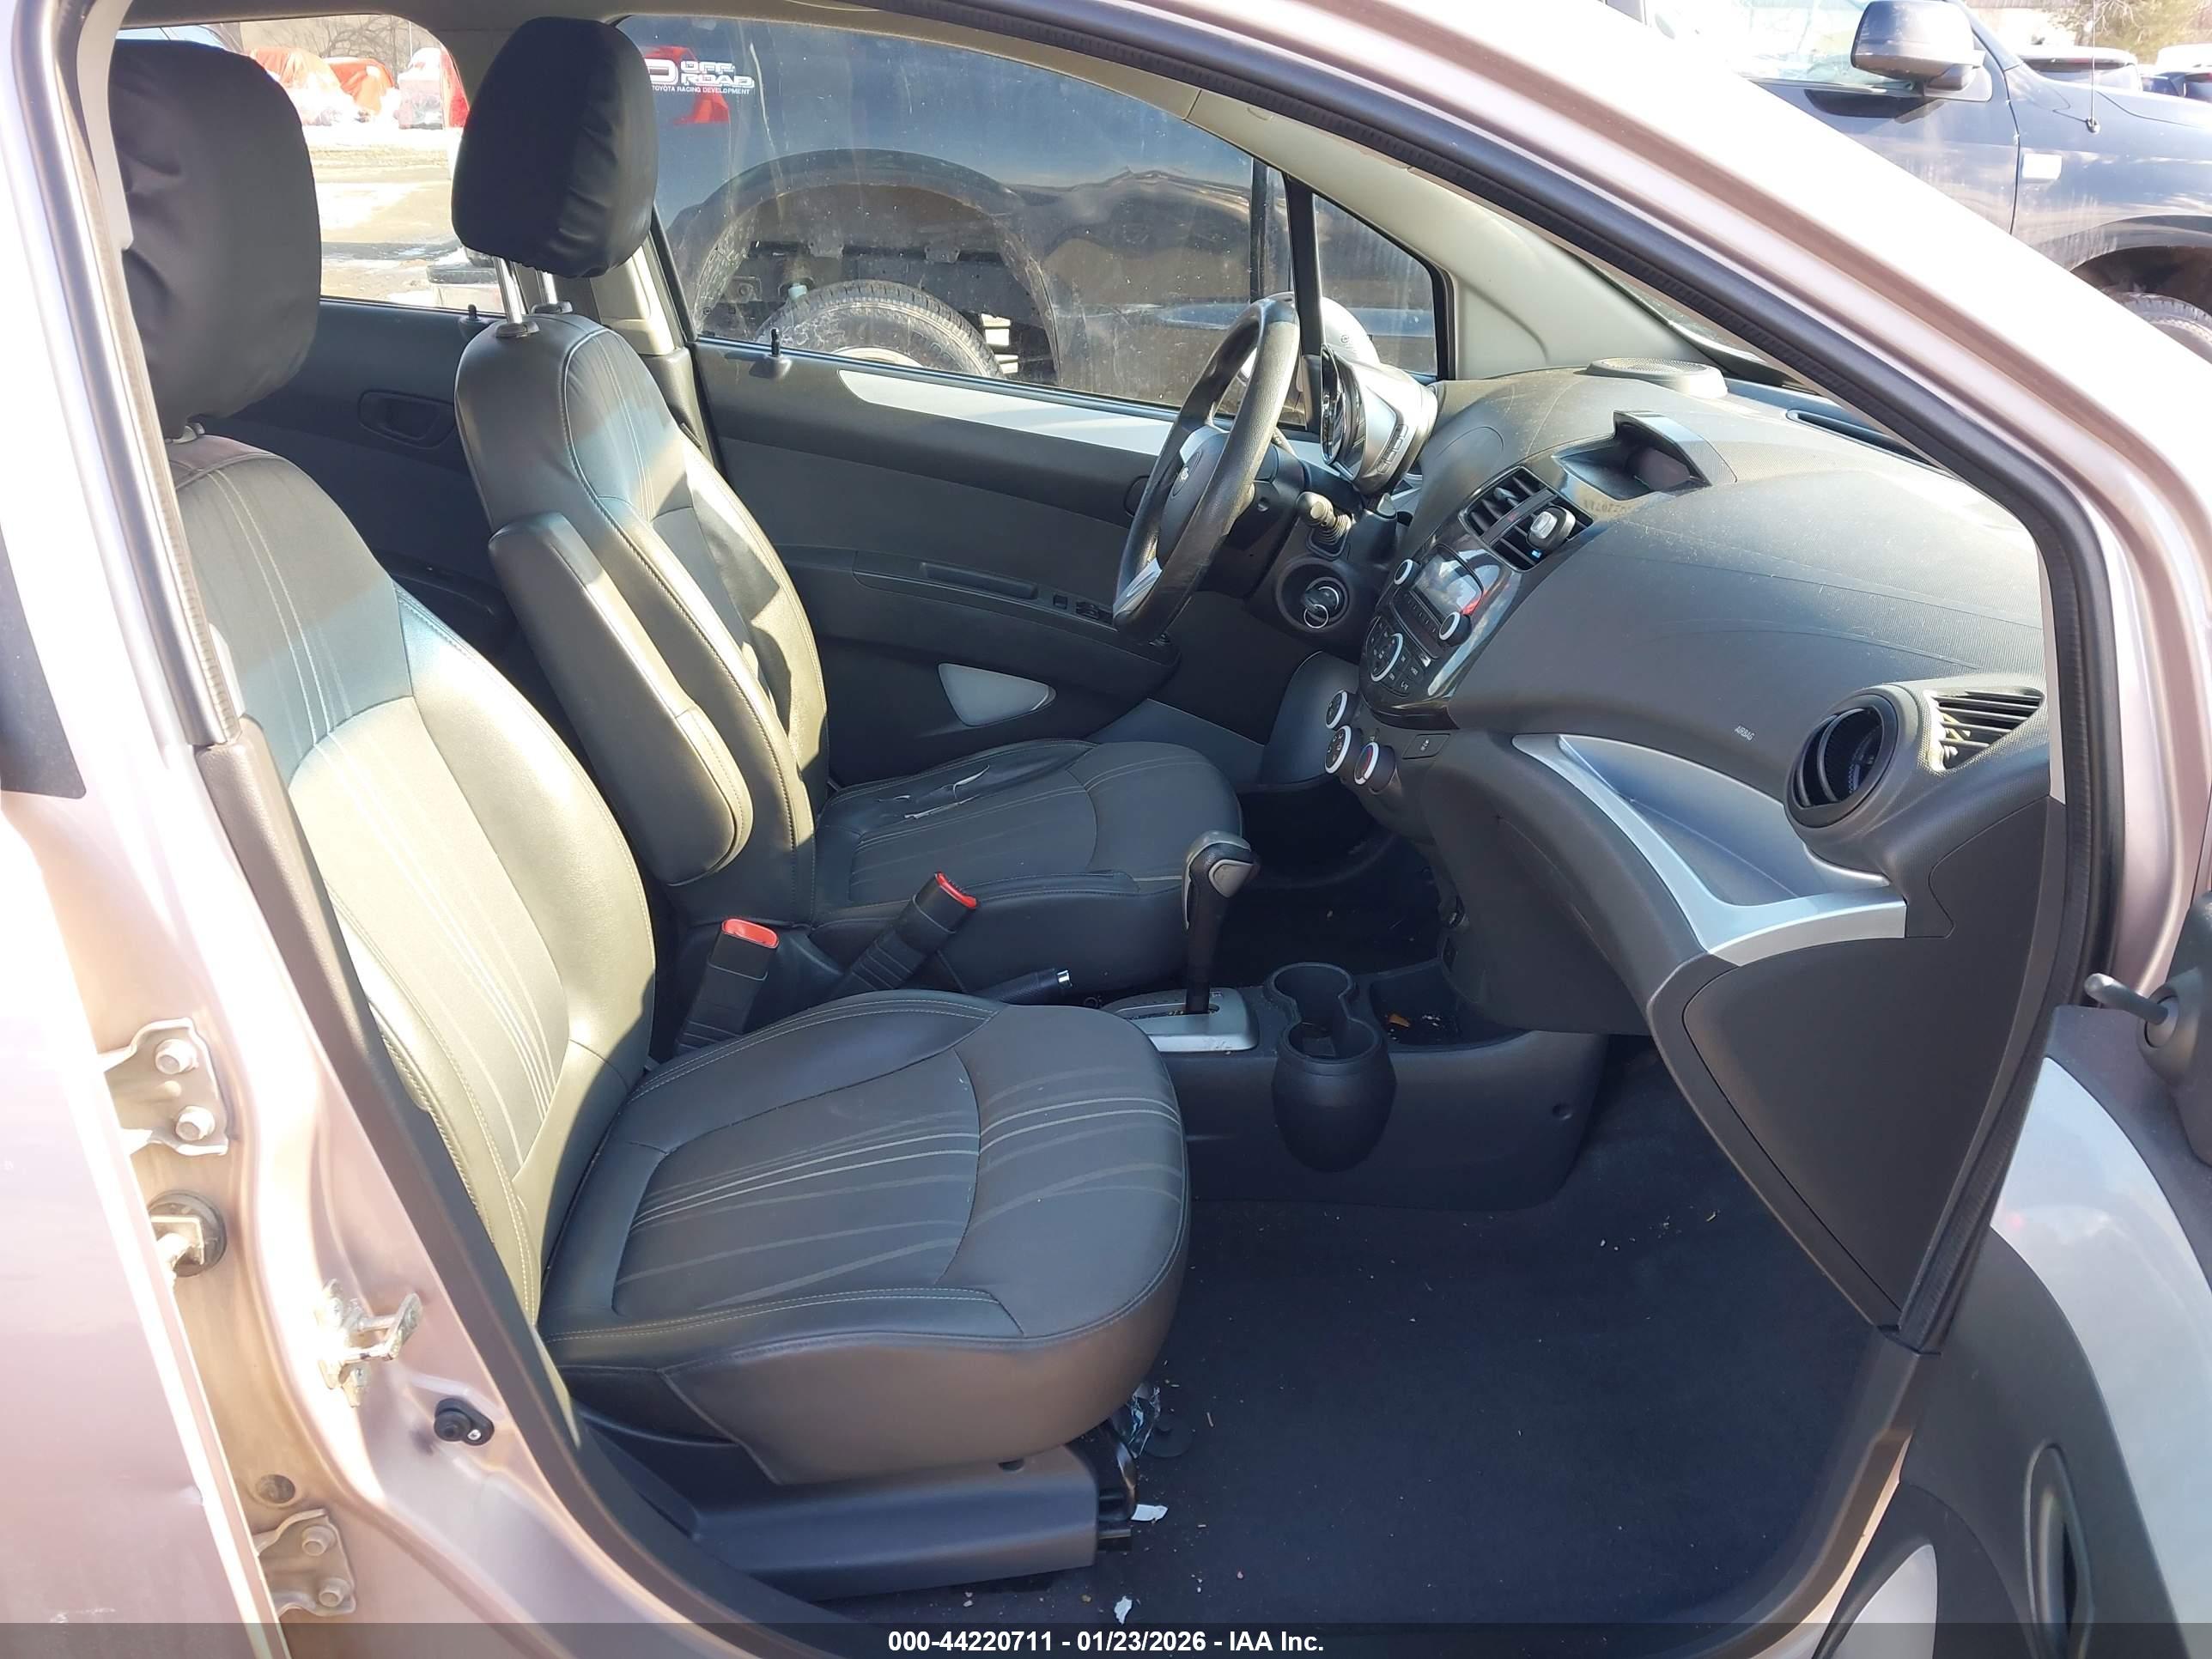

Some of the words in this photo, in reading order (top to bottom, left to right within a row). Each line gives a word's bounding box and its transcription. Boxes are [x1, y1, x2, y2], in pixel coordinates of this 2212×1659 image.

[681, 60, 736, 74] OFF
[681, 72, 755, 88] ROAD
[702, 86, 750, 94] DEVELOPMENT
